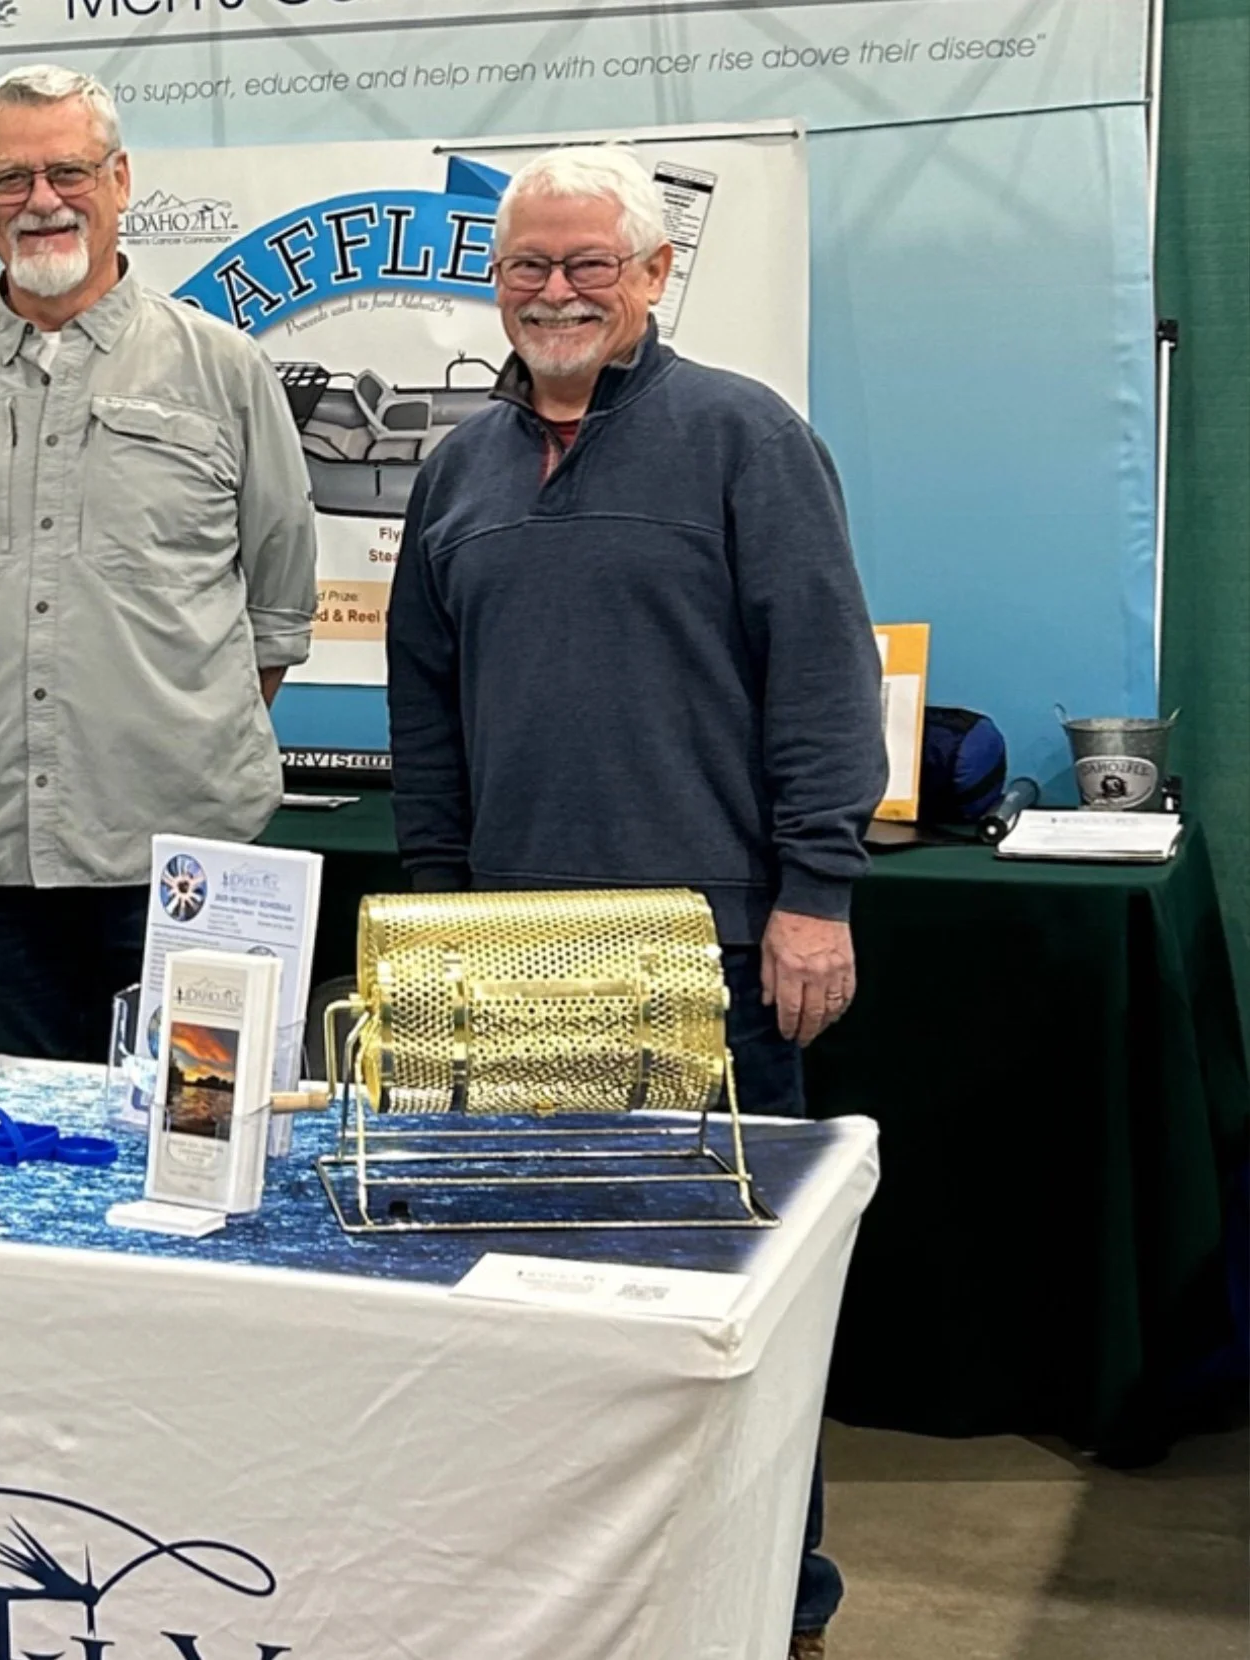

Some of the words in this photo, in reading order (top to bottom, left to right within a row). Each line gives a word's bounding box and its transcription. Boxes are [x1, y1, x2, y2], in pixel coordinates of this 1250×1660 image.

[113, 80, 137, 102] to
[143, 76, 236, 103] support,
[244, 67, 350, 97] educate
[356, 65, 408, 91] and
[413, 60, 469, 89] help
[476, 62, 537, 84] men
[543, 54, 595, 81] with
[602, 51, 701, 77] cancer
[707, 46, 754, 72] rise
[761, 44, 850, 70] above
[858, 37, 921, 65] their
[125, 210, 233, 232] IDAHO2FLY
[184, 204, 496, 331] AFFLE
[332, 609, 344, 623] &
[347, 609, 381, 623] Reel
